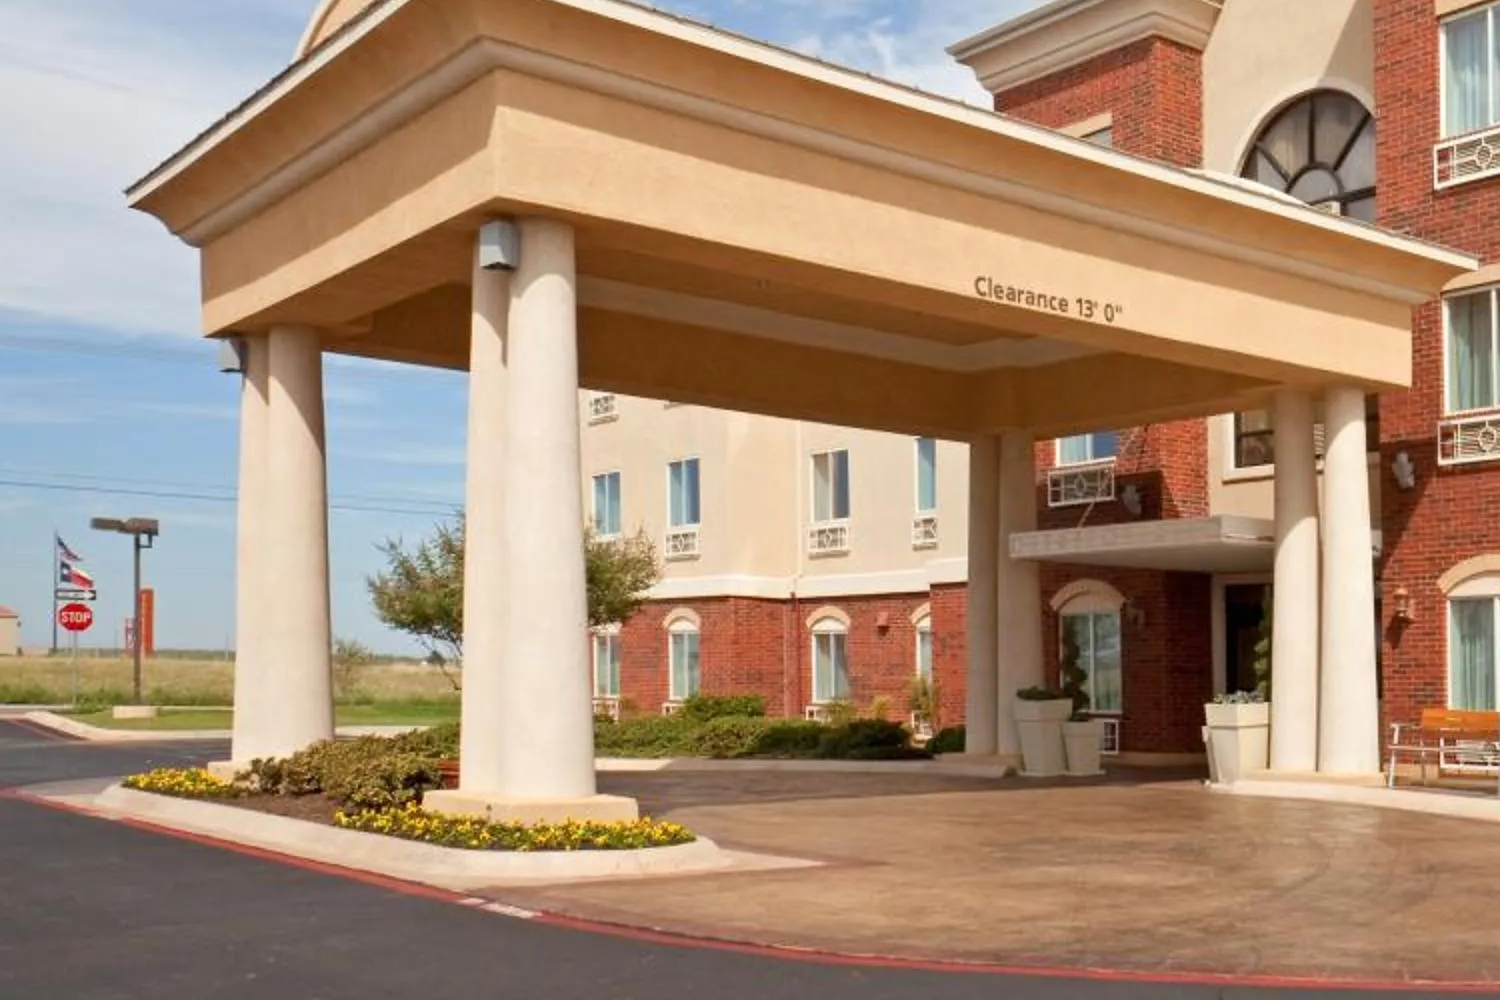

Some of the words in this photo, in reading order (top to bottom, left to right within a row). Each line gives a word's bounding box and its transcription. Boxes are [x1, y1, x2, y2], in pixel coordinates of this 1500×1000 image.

[974, 276, 1069, 313] Clearance
[1075, 297, 1098, 318] 13'
[61, 611, 91, 623] STOP
